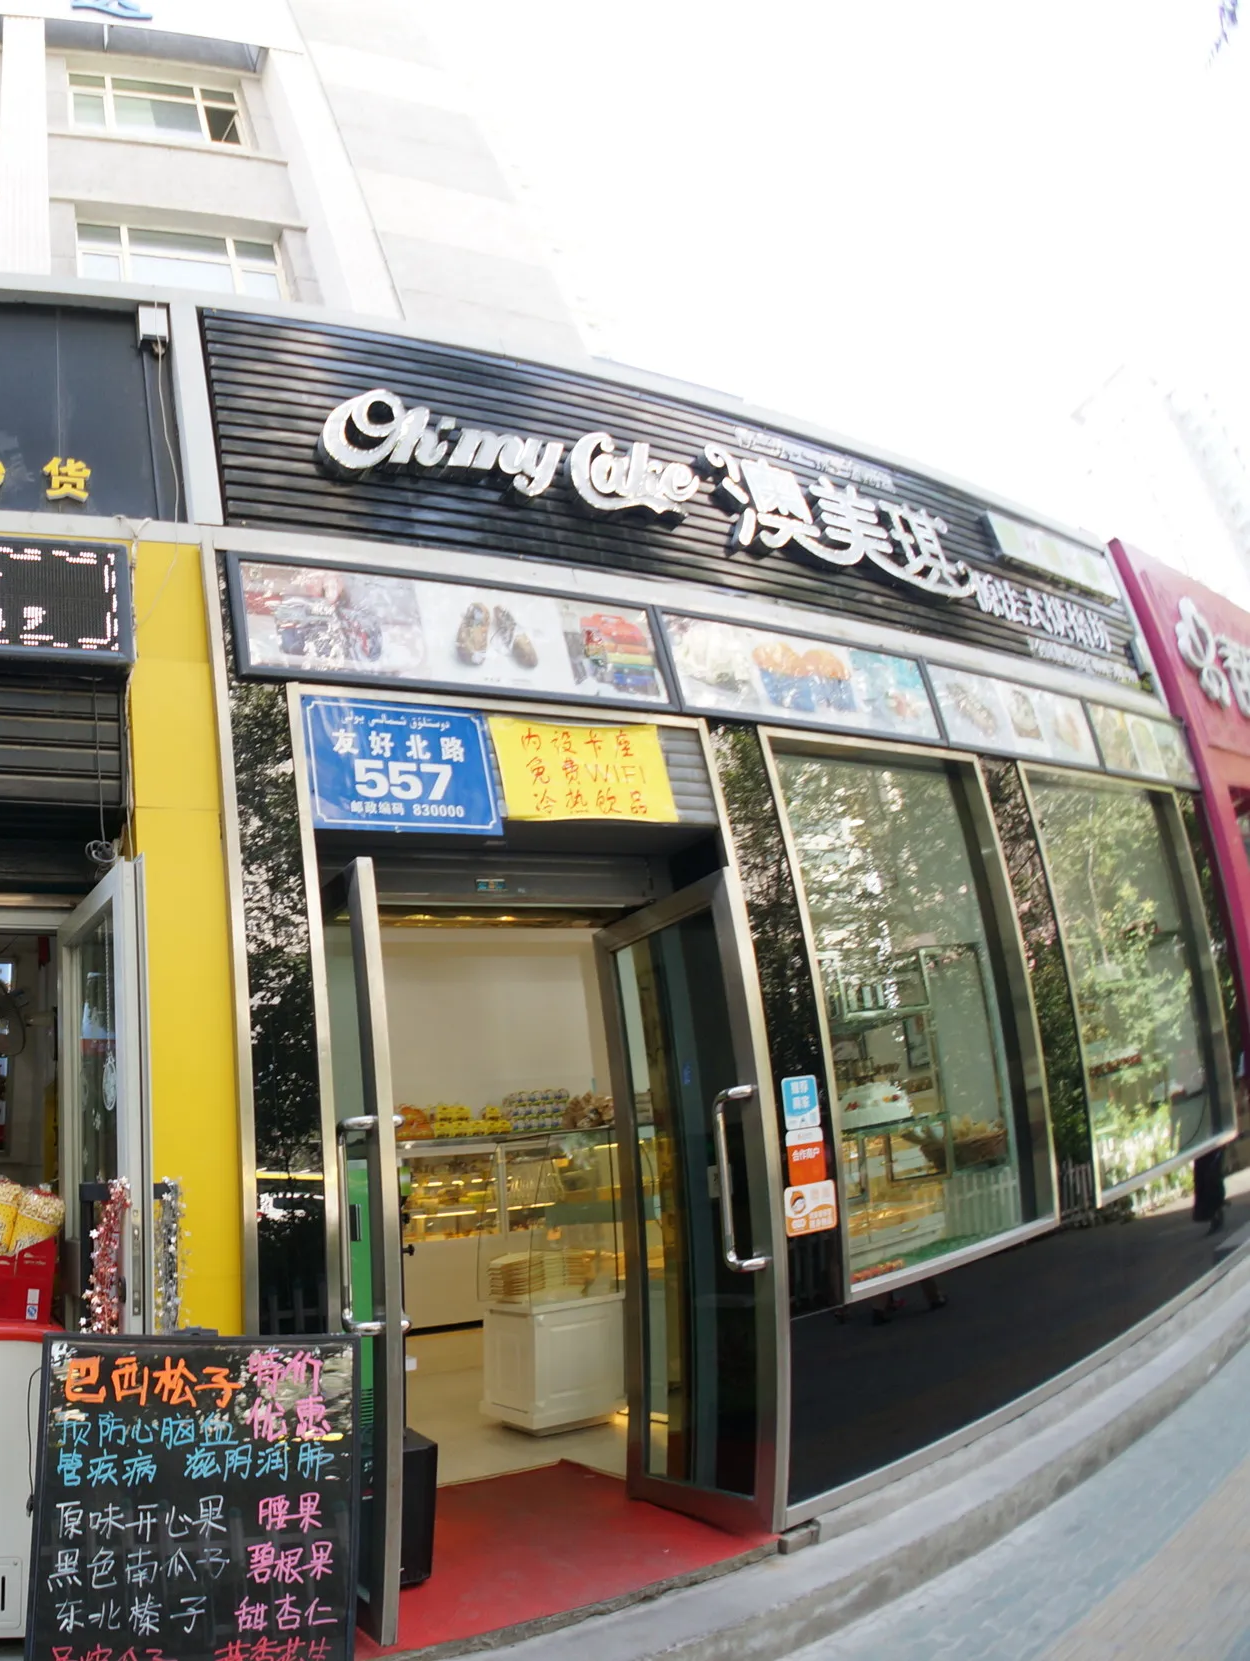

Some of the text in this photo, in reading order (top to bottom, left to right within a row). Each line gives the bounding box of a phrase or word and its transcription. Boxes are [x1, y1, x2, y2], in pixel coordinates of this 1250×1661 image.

[569, 432, 701, 514] Cake
[332, 728, 465, 763] 友好北路
[521, 727, 634, 758] 内设卡座
[354, 759, 452, 801] 557
[533, 788, 648, 815] 冷热饮品
[351, 801, 465, 818] 邮政编码 830000
[65, 1355, 243, 1408] 巴西松子
[247, 1350, 324, 1396] 特价
[55, 1410, 239, 1448] 预防心脑血
[245, 1397, 331, 1441] 优惠
[57, 1441, 335, 1487] 管疾病 滋阴润肺
[56, 1492, 323, 1541] 原味开心果 腰果
[47, 1541, 334, 1591] 黑色南瓜子 碧根果
[55, 1592, 338, 1636] 东北榛子 甜杏仁
